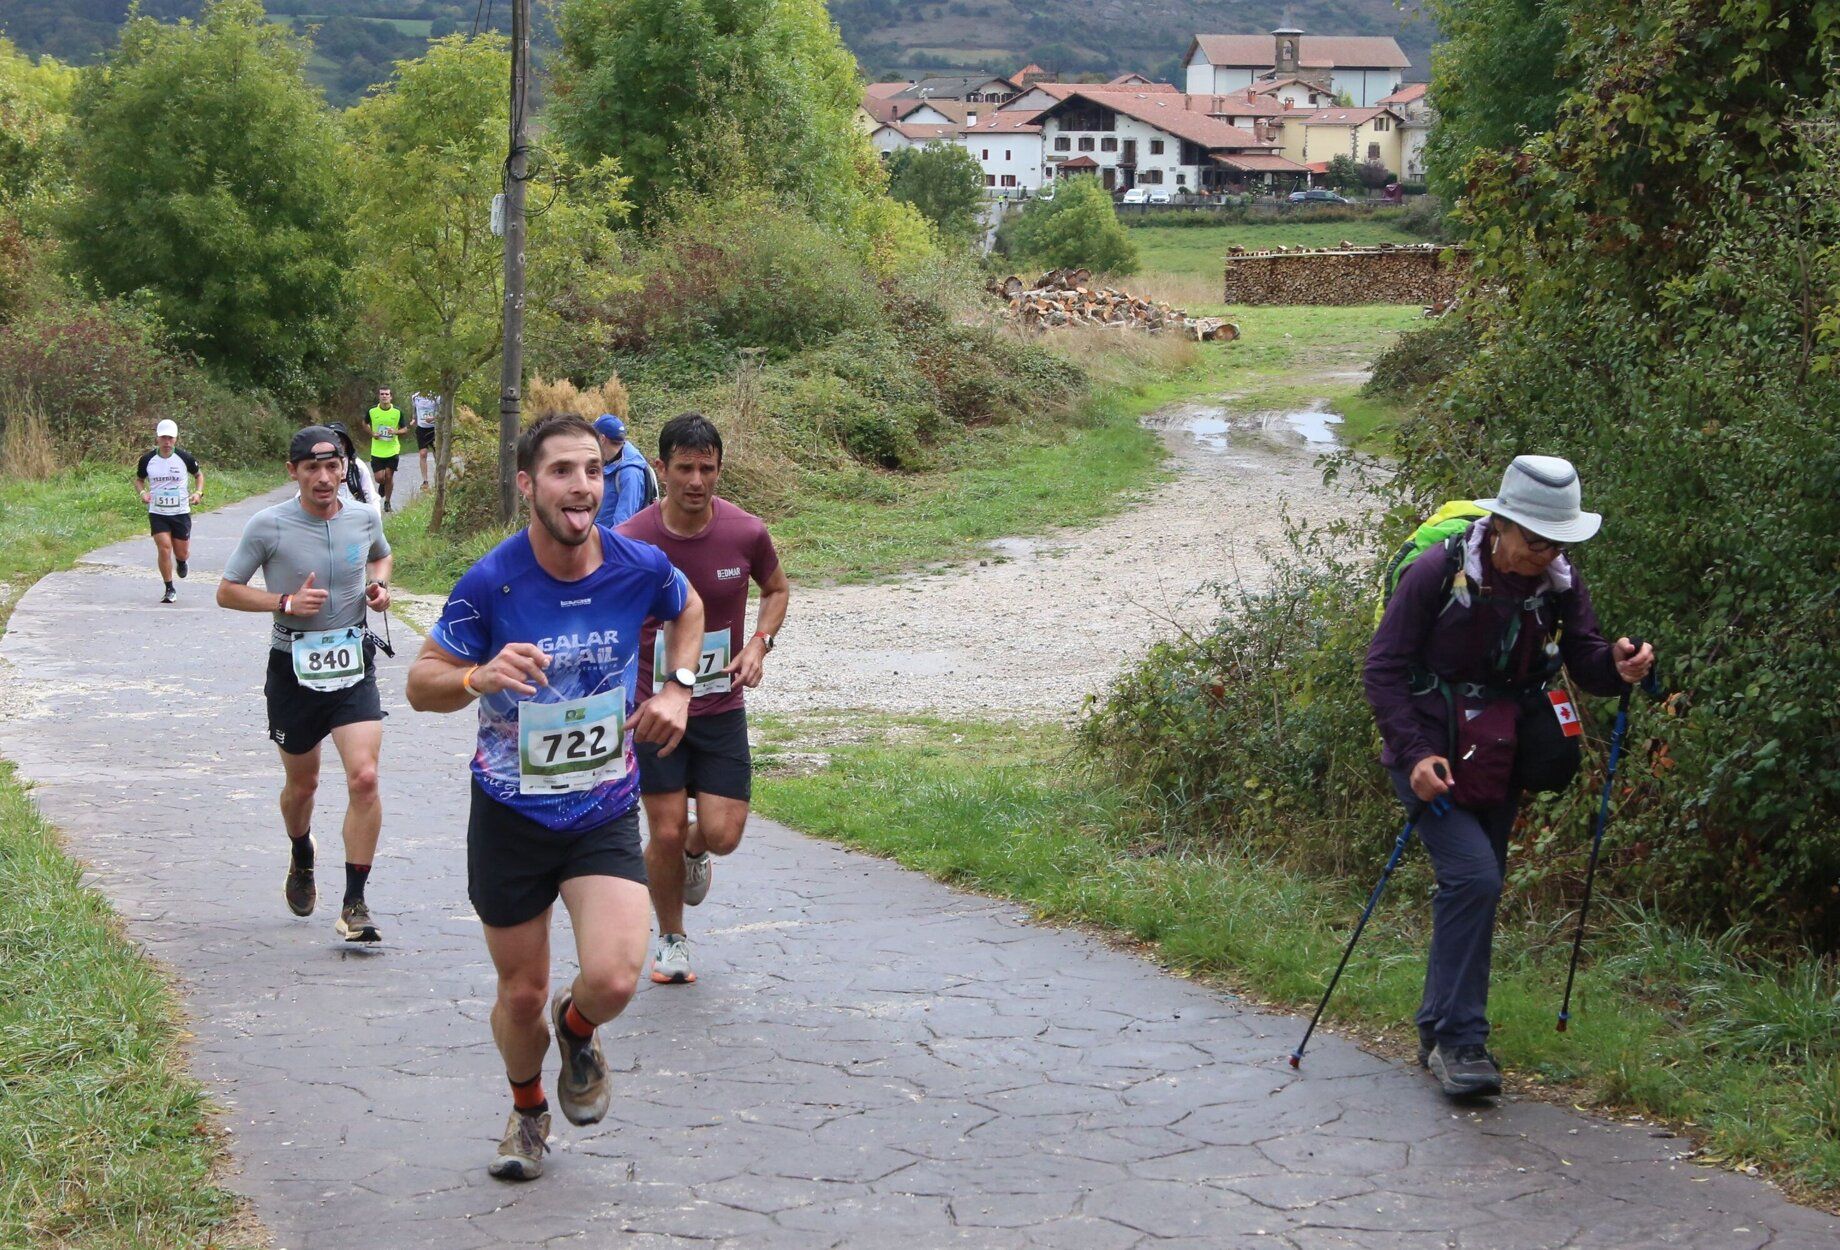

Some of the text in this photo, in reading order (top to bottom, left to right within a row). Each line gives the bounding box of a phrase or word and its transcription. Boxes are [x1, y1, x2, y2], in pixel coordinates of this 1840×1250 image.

[159, 496, 174, 504] 511
[537, 630, 620, 652] GALAR
[308, 648, 350, 671] 840
[549, 646, 619, 671] RAIL
[542, 725, 608, 763] 722
